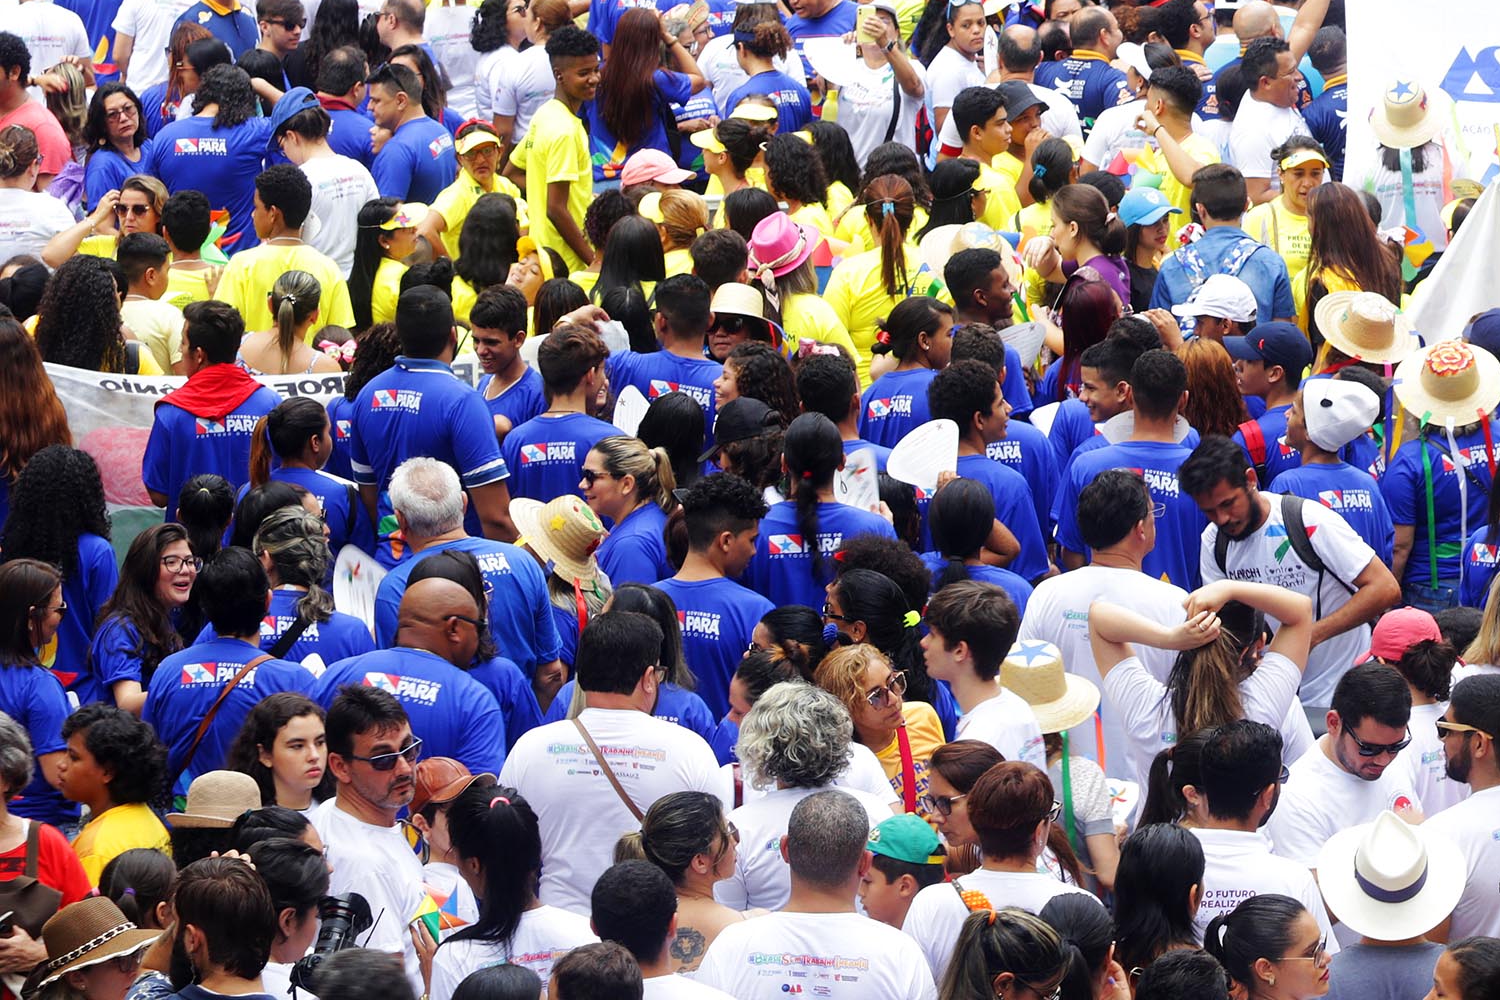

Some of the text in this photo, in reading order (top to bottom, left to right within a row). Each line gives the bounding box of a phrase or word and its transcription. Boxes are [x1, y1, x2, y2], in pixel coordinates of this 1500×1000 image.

[547, 446, 576, 461] PARÁ
[477, 556, 512, 573] ARÁ
[686, 615, 721, 636] PARÁ
[397, 680, 440, 703] PARÁ
[1216, 890, 1257, 900] FUTURO
